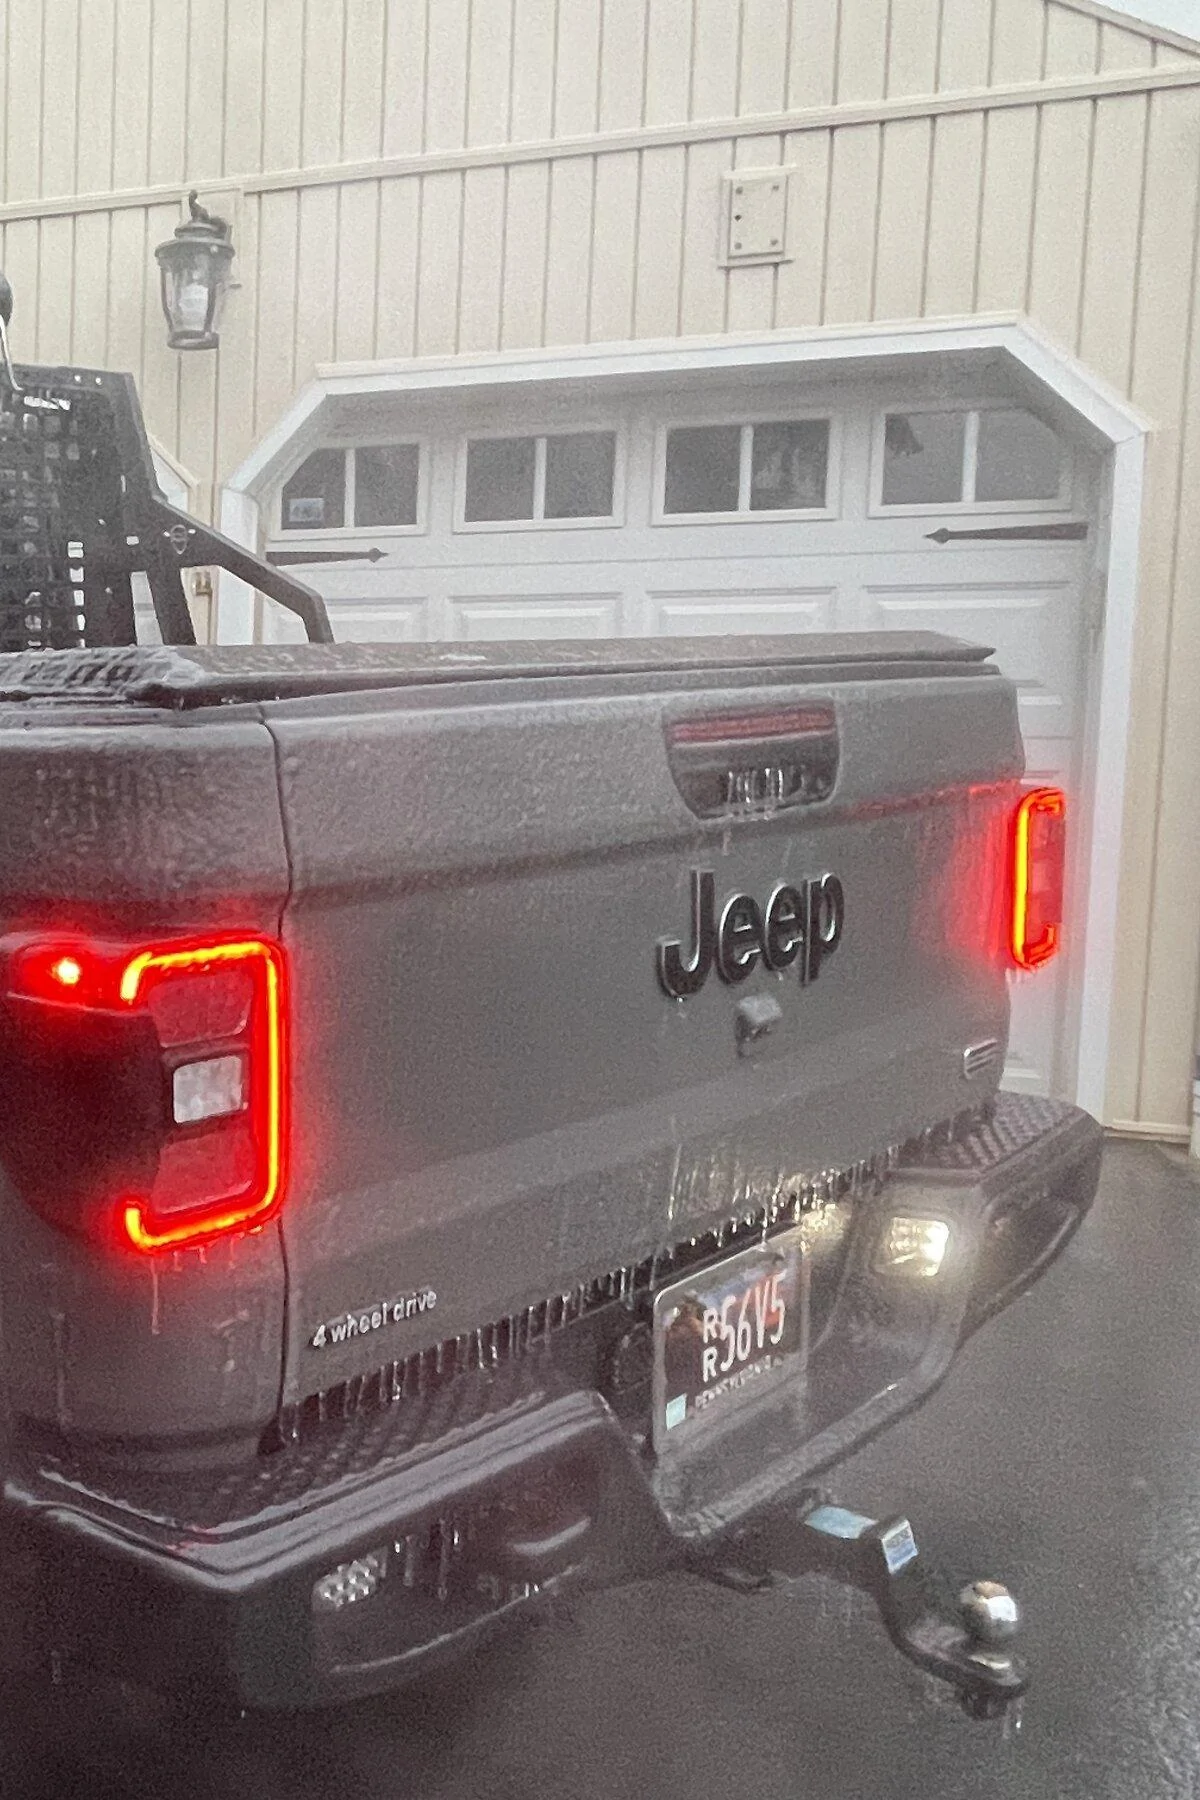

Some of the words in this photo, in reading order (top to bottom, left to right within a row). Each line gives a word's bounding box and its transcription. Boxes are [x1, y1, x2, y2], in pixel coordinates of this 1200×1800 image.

[656, 869, 844, 997] Jeep
[312, 1325, 327, 1348] 4
[330, 1303, 388, 1343] wheel
[393, 1291, 437, 1322] drive
